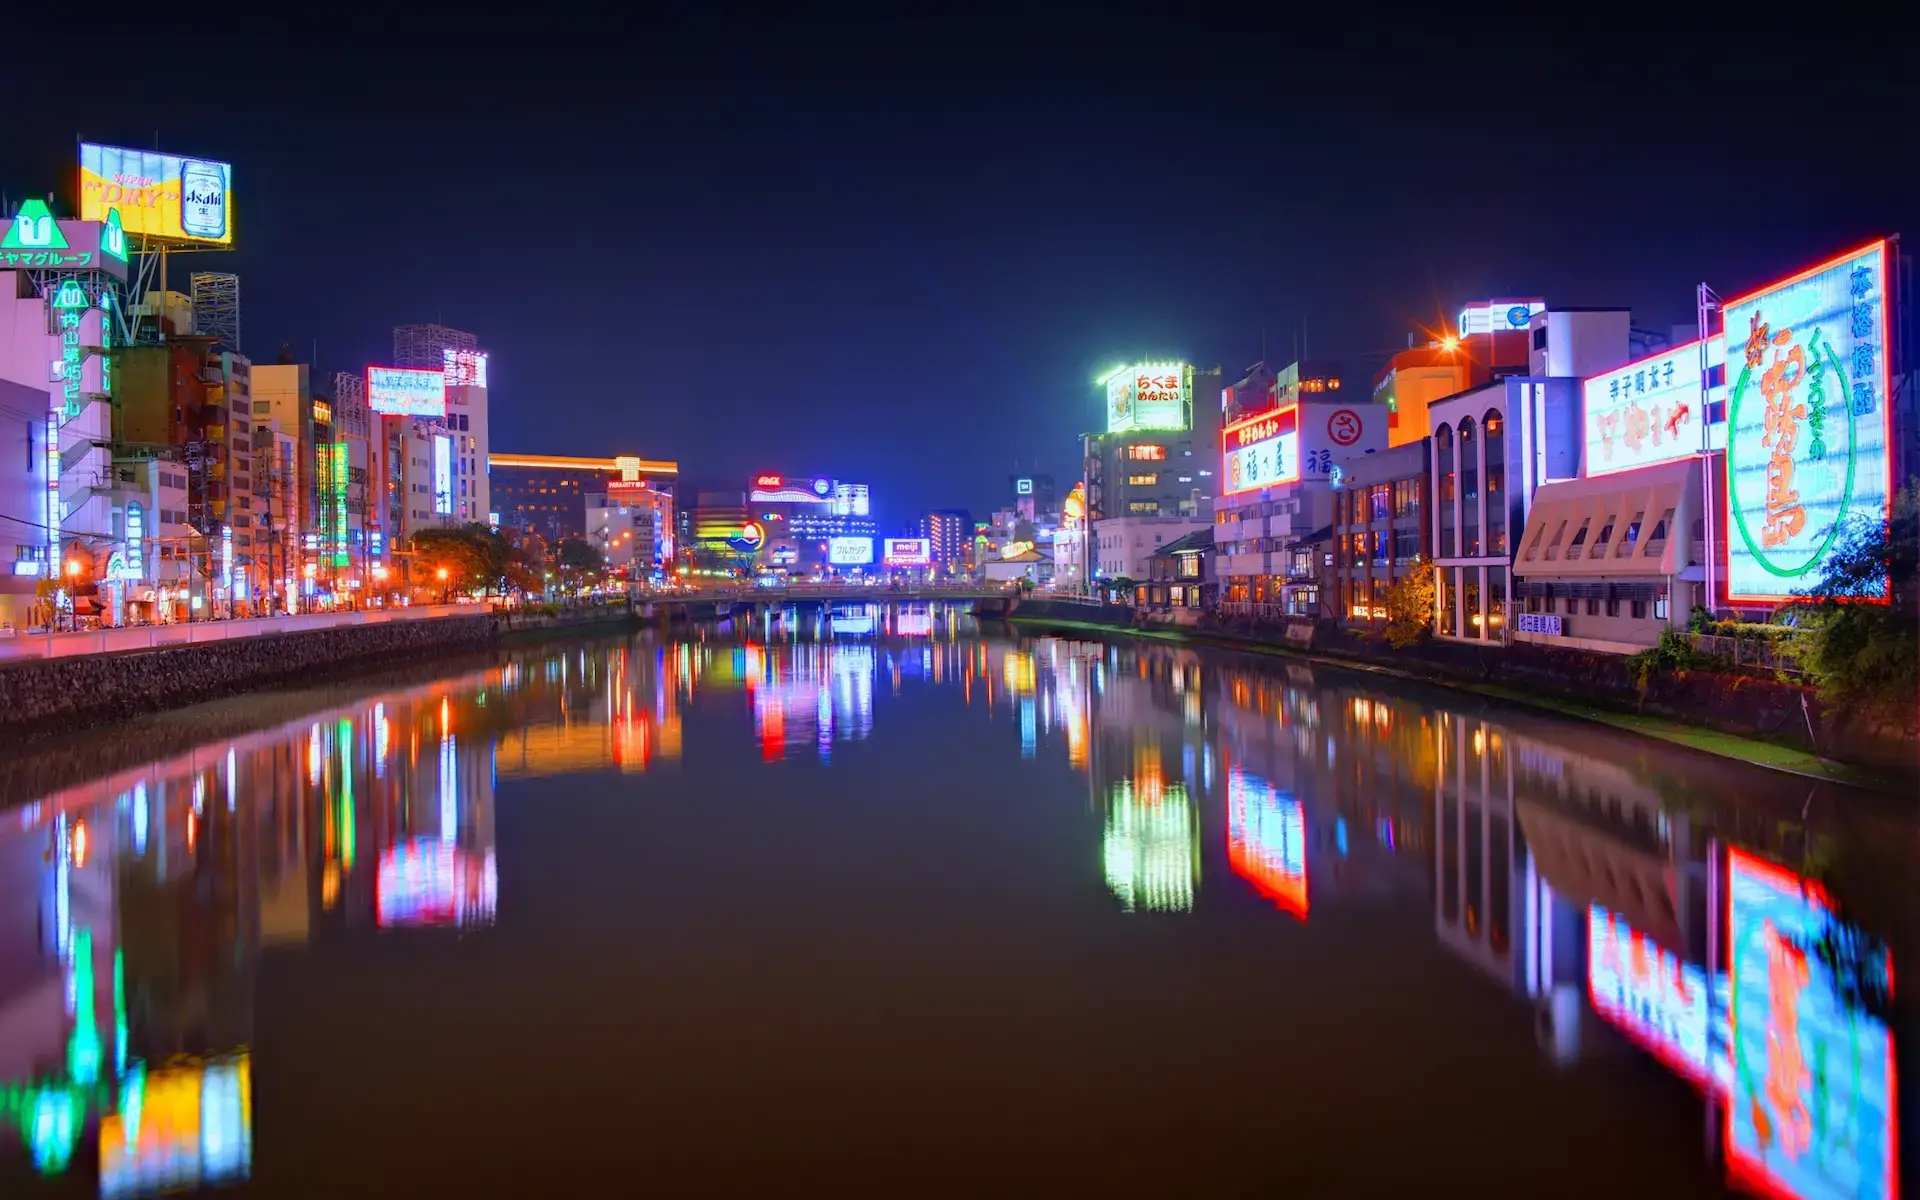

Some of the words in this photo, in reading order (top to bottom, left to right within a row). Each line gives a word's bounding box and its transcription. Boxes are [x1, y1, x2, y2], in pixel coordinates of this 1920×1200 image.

[186, 189, 222, 207] Asahi
[1850, 265, 1877, 417] 本格焼酎
[1136, 374, 1178, 390] ちくま
[1609, 360, 1675, 402] 辛子明太子
[1137, 391, 1179, 401] めんたい
[896, 542, 918, 551] meiji
